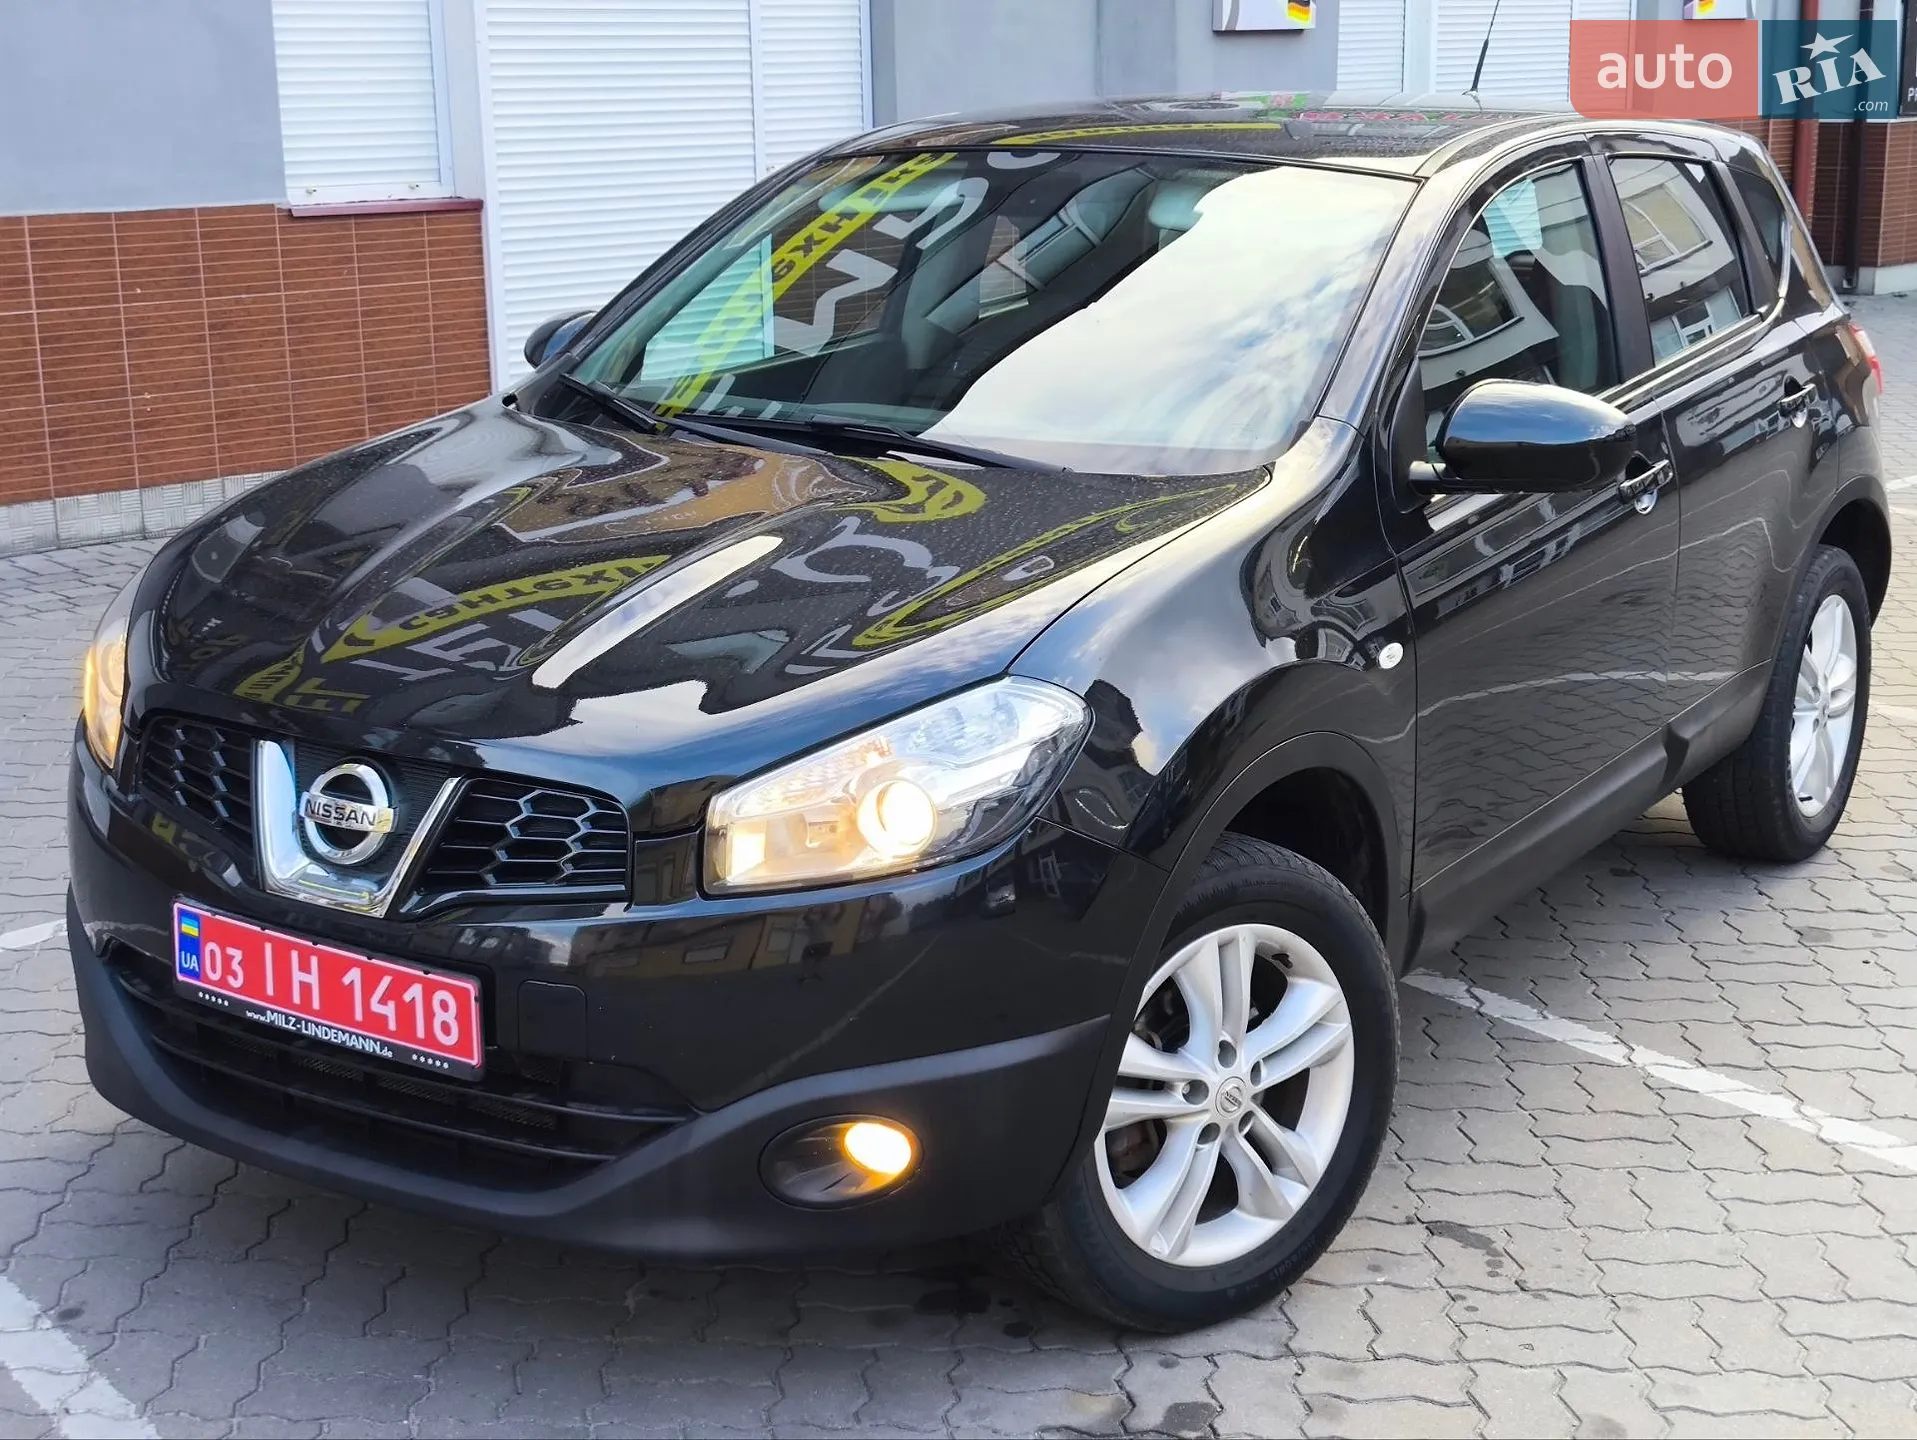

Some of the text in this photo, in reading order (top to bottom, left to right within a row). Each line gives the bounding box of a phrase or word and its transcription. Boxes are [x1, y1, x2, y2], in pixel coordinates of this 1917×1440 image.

[304, 798, 377, 826] NISSAN
[181, 950, 200, 972] UA
[204, 941, 244, 988] 03
[342, 966, 460, 1046] 1418
[246, 1010, 393, 1058] www.MILZ-LINDEMANN.de
